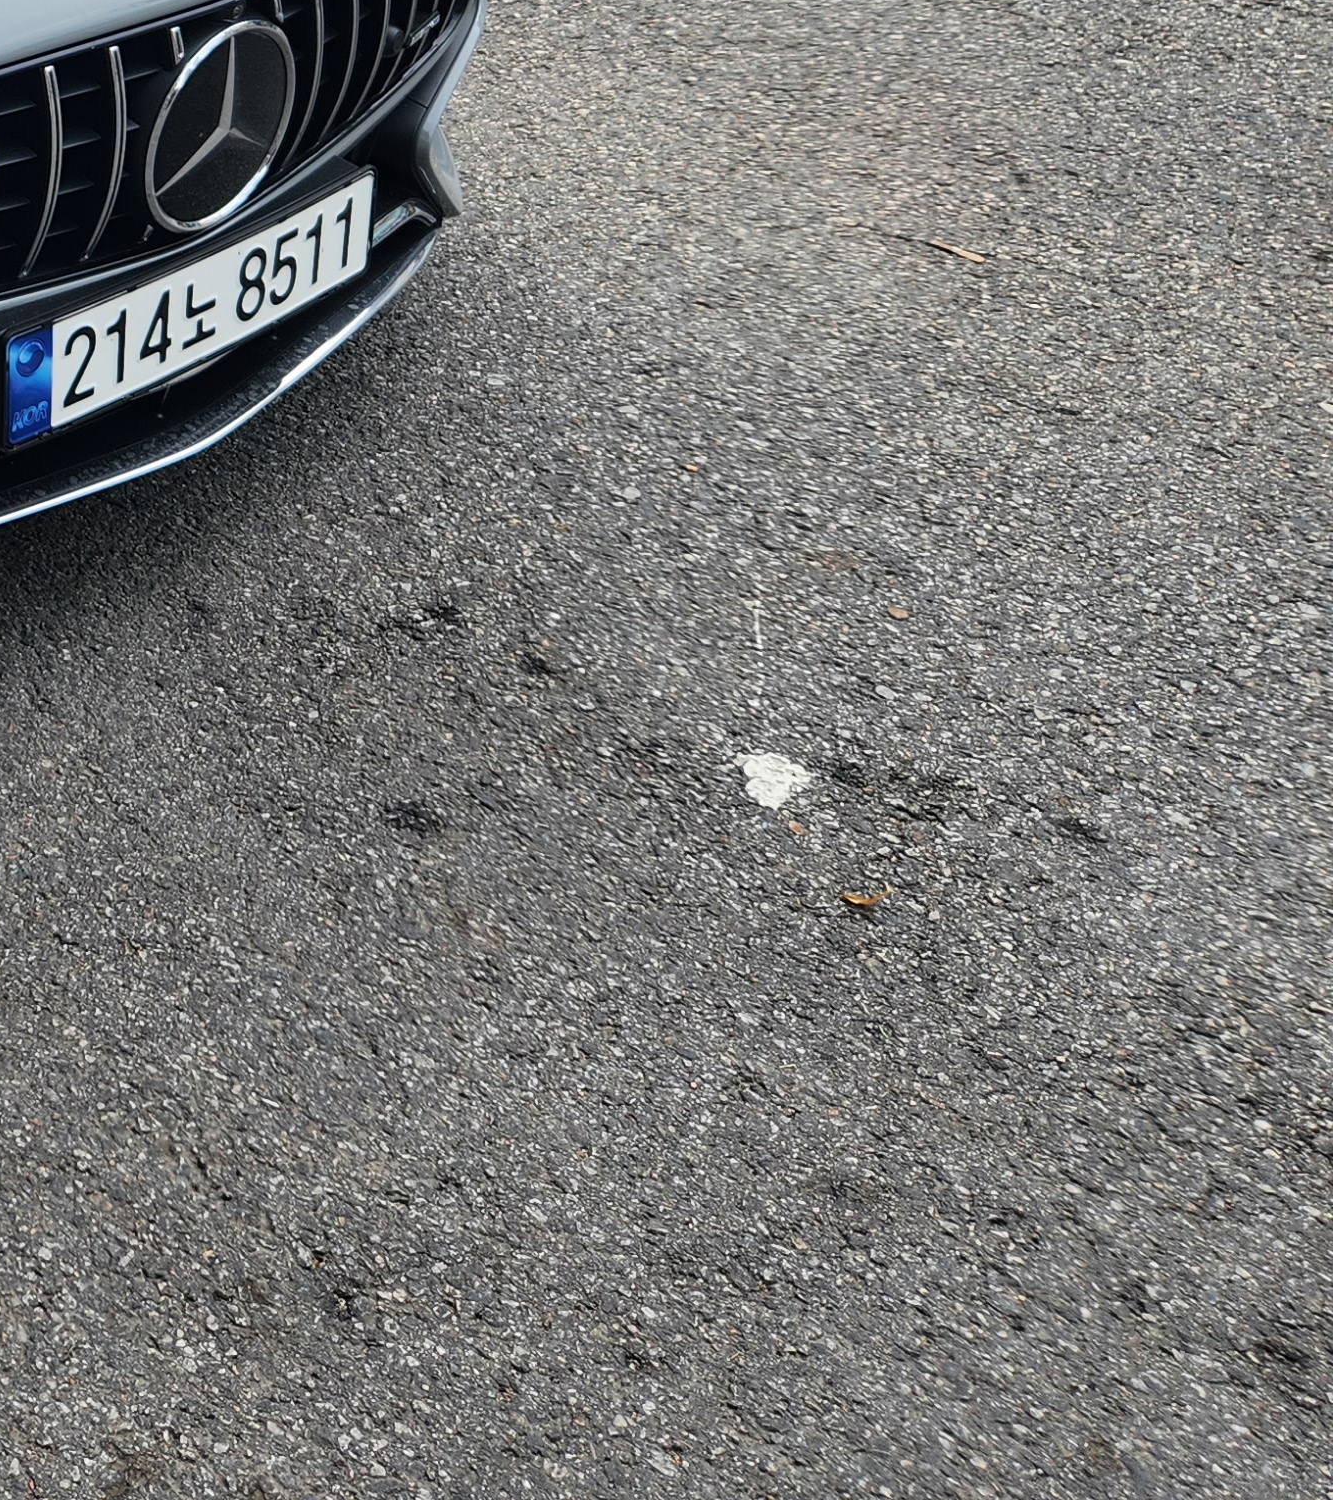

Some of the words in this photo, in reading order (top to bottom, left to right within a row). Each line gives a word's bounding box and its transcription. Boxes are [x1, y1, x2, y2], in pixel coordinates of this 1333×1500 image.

[62, 283, 216, 409] 214노
[235, 196, 354, 322] 8511
[11, 400, 49, 431] KOR
